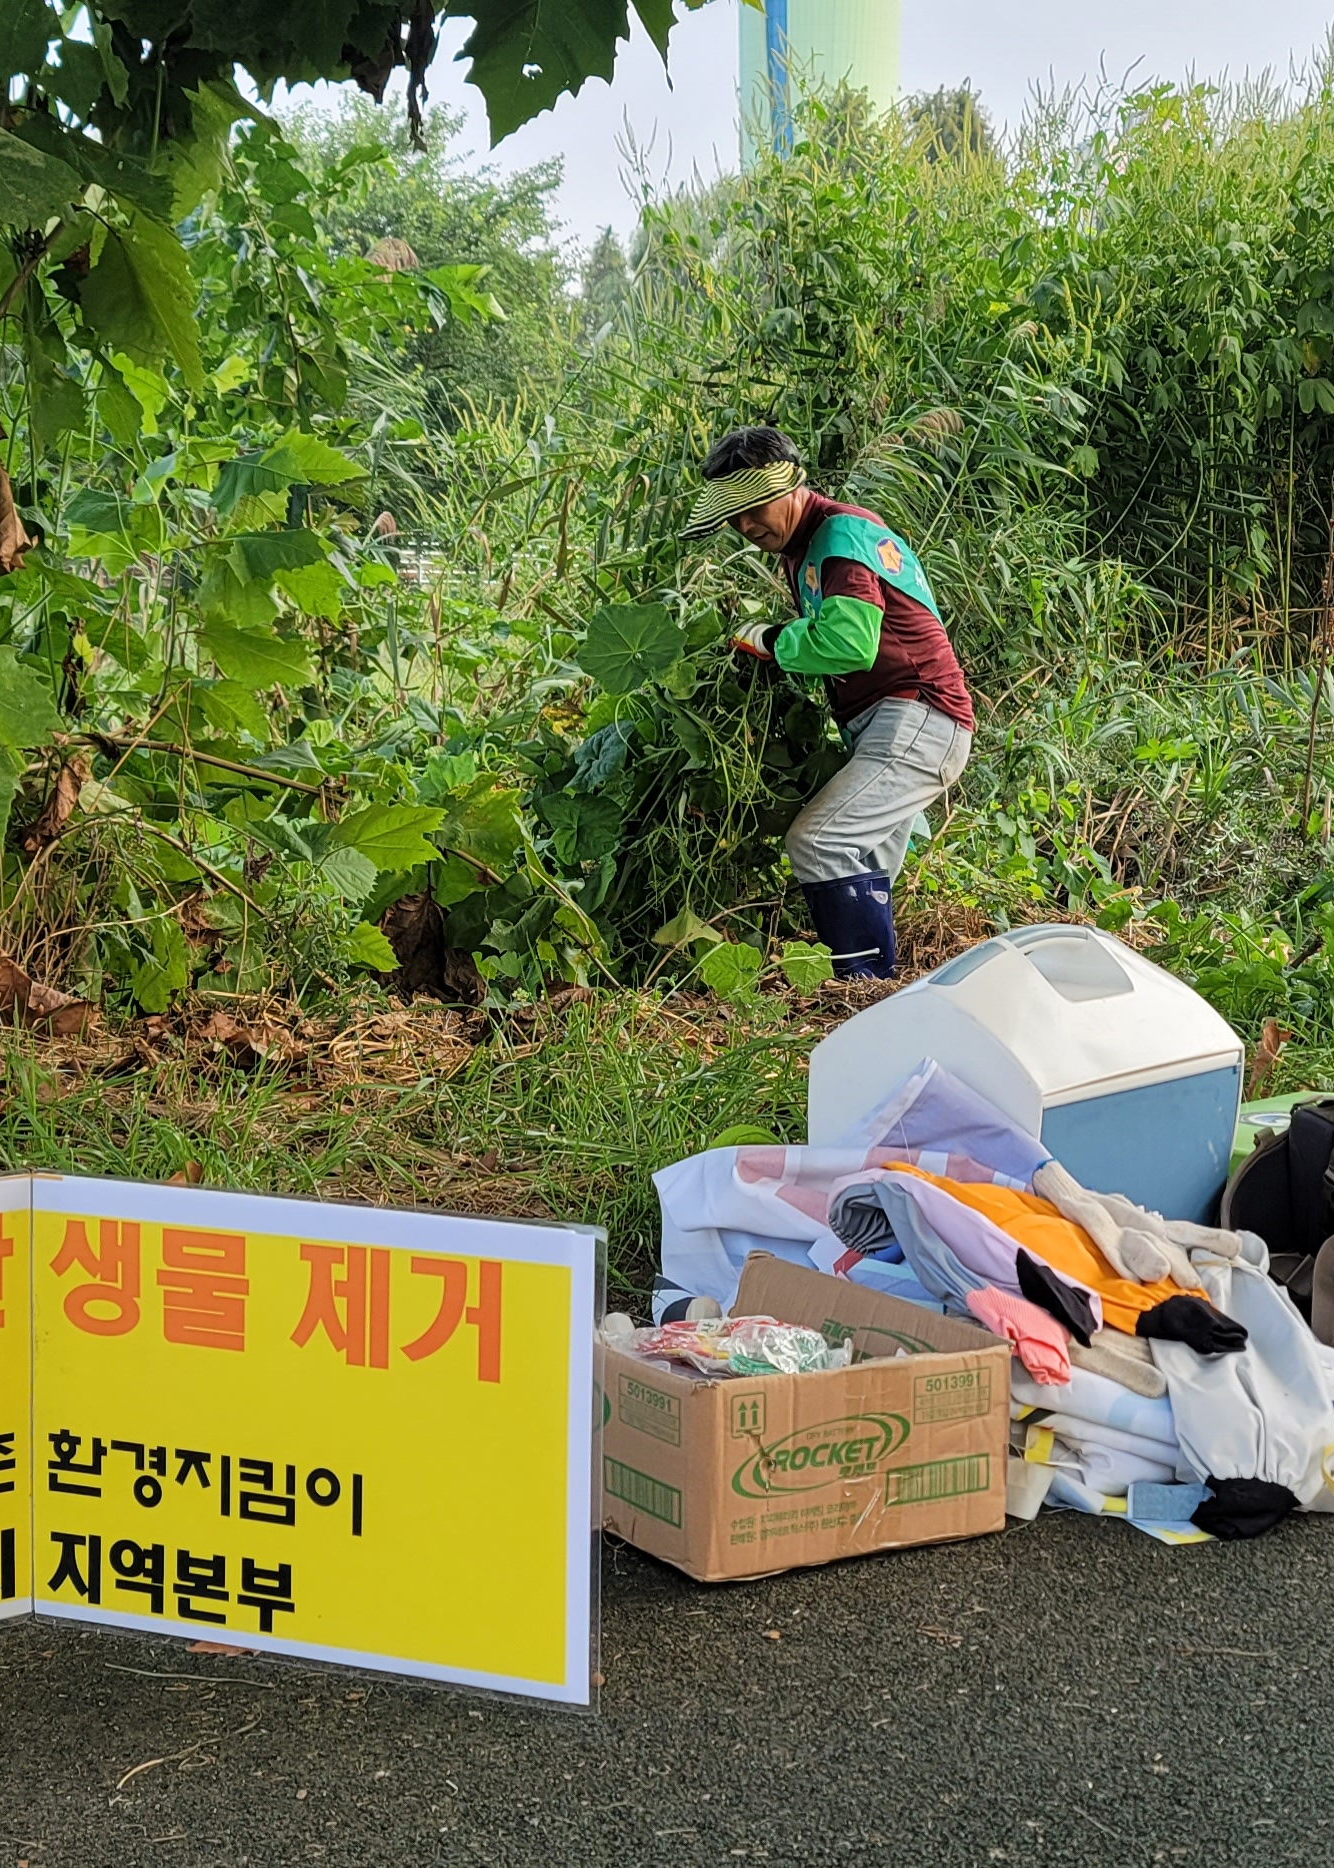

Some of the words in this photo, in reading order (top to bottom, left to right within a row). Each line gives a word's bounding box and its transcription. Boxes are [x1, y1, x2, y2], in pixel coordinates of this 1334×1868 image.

[51, 1220, 250, 1352] 생물
[291, 1243, 502, 1384] 제거
[627, 1381, 671, 1413] 5013991
[925, 1371, 980, 1392] 5013991
[48, 1428, 363, 1537] 환경지킴이
[775, 1435, 882, 1473] ROCKET
[47, 1531, 296, 1634] 지역본부
